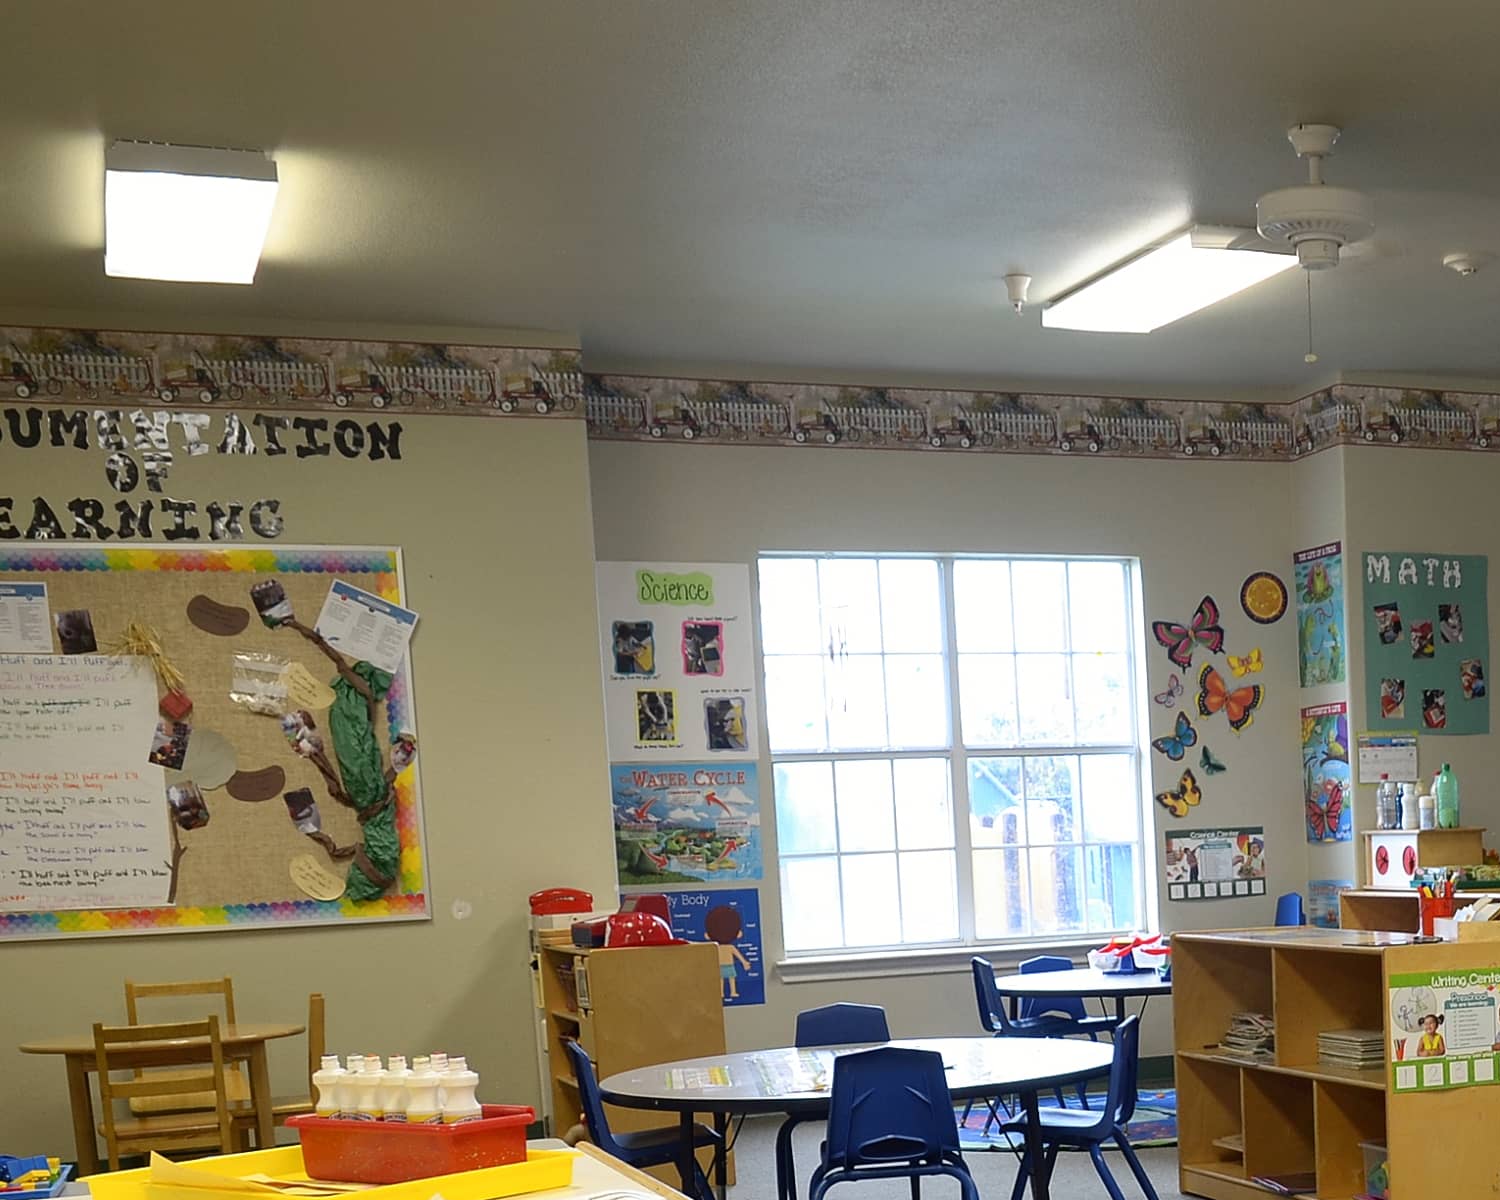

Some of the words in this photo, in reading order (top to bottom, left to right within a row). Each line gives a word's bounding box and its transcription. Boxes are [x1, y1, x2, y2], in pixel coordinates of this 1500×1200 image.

[0, 407, 403, 461] UMENTATION
[105, 451, 173, 493] OF
[1367, 555, 1461, 588] MATH
[641, 573, 709, 601] Science
[632, 770, 688, 788] WATER
[694, 770, 746, 786] CYCLE
[667, 896, 678, 908] y
[681, 894, 710, 907] Body
[1431, 974, 1466, 989] Writing
